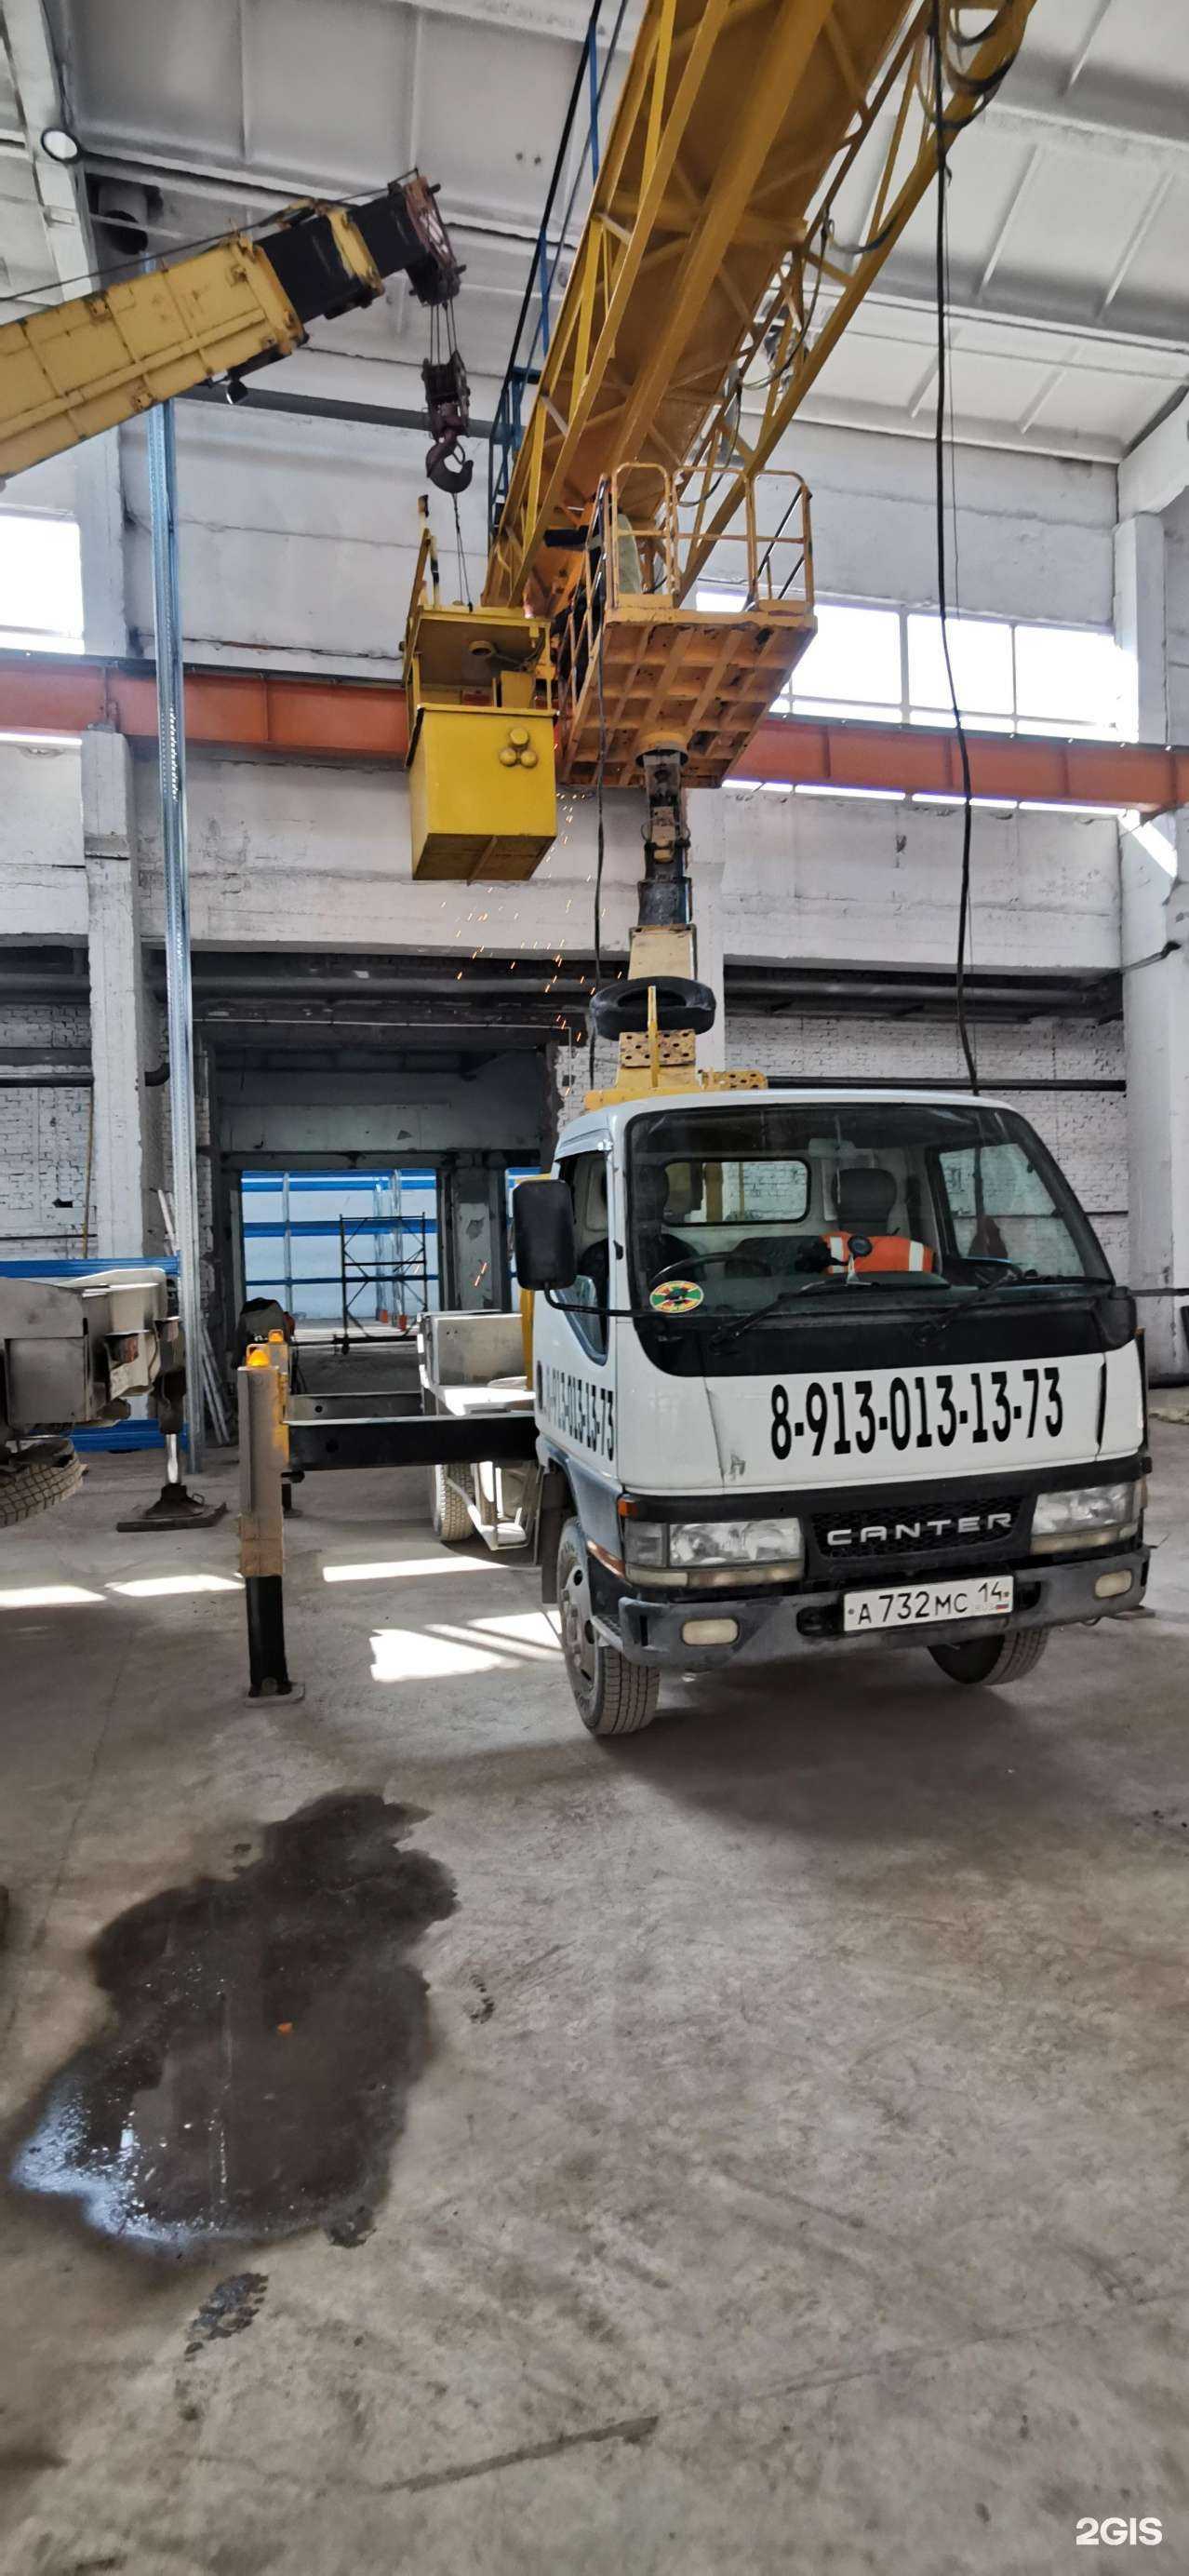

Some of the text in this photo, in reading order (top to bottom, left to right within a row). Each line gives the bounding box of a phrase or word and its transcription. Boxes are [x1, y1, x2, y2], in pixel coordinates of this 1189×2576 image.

[771, 1367, 1063, 1460] 8-913-013-13-73
[826, 1513, 1012, 1547] CANTER
[978, 1581, 1003, 1603] 14
